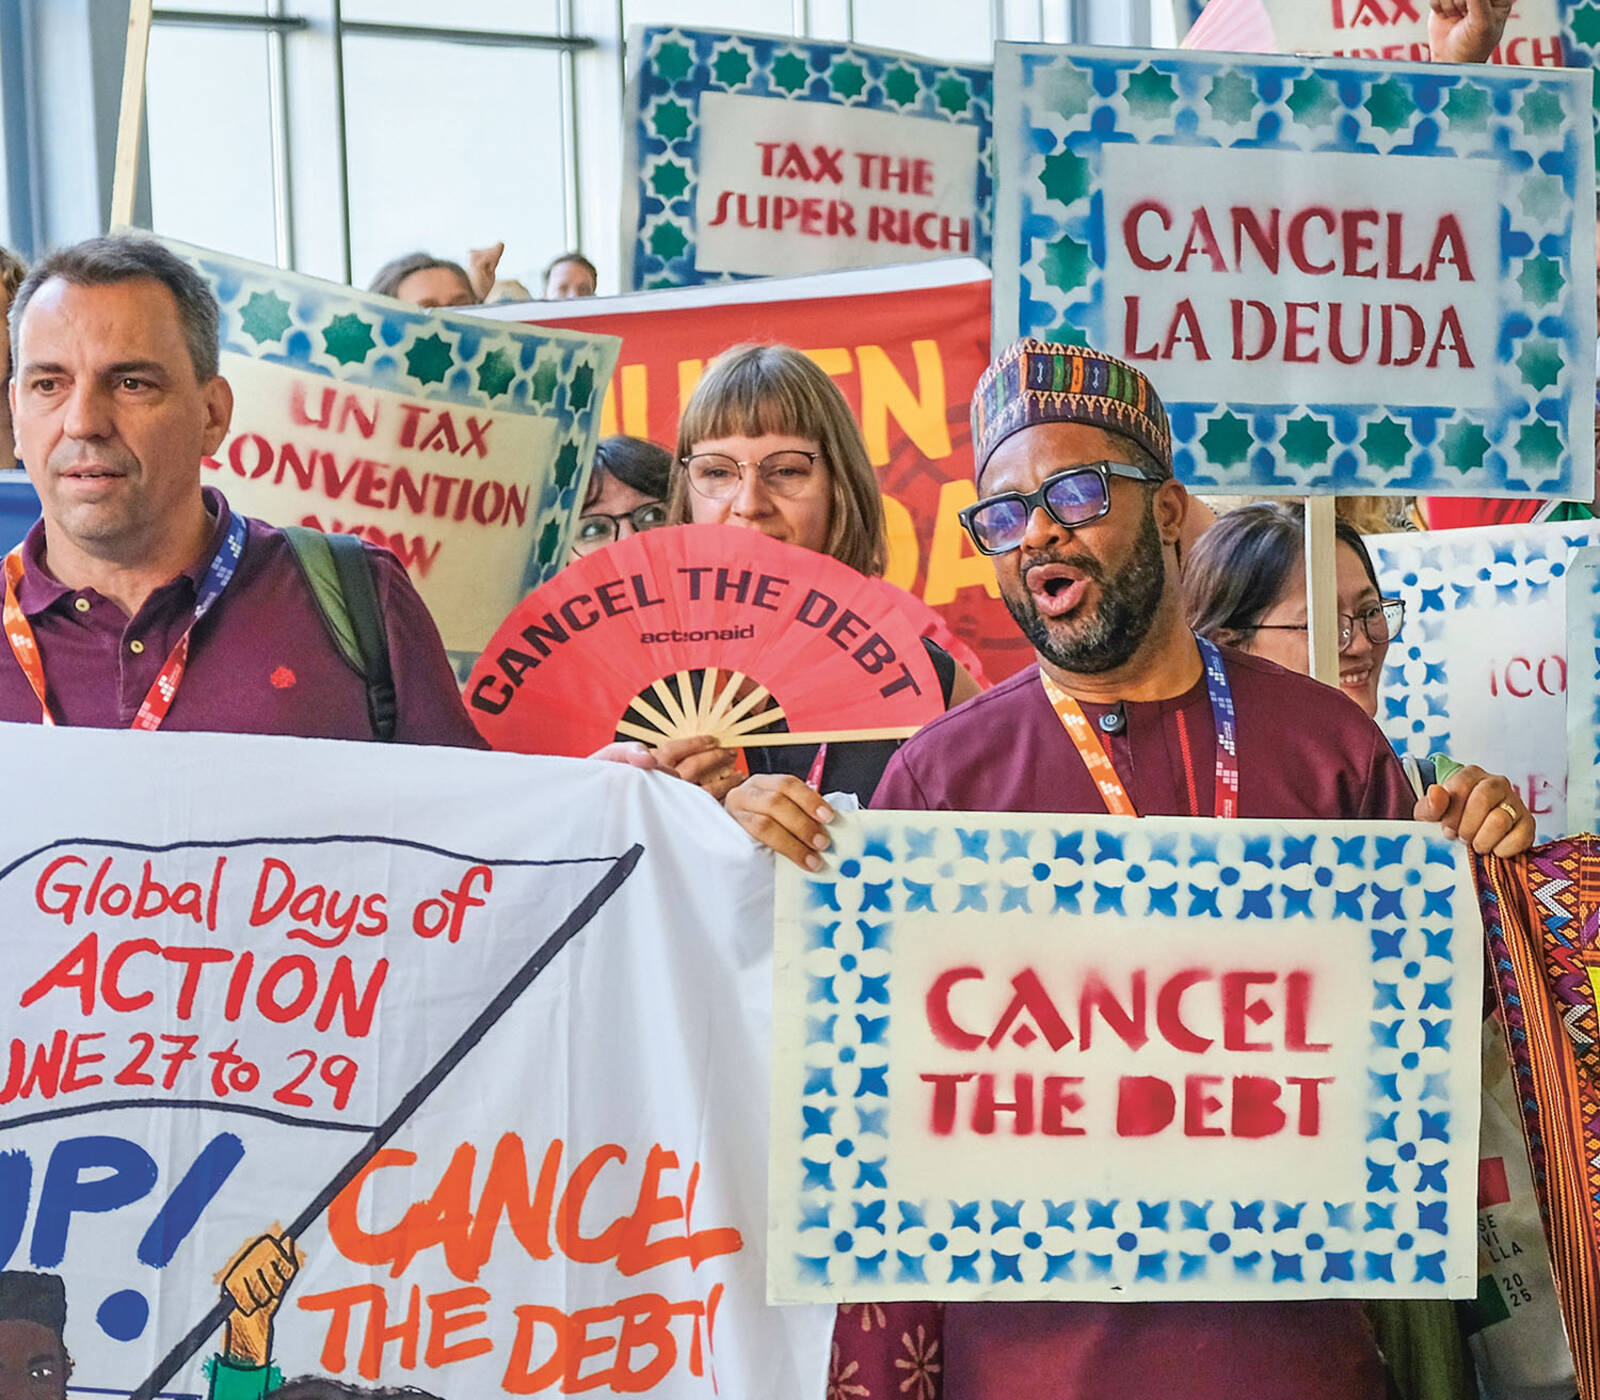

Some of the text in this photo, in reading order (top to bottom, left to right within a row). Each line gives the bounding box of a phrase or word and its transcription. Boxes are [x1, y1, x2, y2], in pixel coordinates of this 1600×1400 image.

[755, 142, 934, 196] TAX THE
[708, 191, 970, 253] SUPER RICH
[1122, 200, 1475, 282] CANCELA
[1124, 296, 1475, 368] LA DEUDA
[290, 380, 493, 459] UN TAX
[202, 432, 531, 528] ONVENTION
[470, 567, 922, 715] CANCEL THE DEBT
[34, 854, 493, 948] Global Days of
[19, 931, 390, 1038] ACTION
[925, 966, 1333, 1054] CANCEL
[114, 1032, 199, 1089] 27
[208, 1039, 260, 1097] to
[273, 1049, 359, 1110] 29
[919, 1072, 1336, 1138] THE DEBT
[327, 1131, 744, 1282] CANCEL
[1488, 1241, 1524, 1263] LLA
[1503, 1273, 1524, 1291] 20
[297, 1283, 495, 1380] THE
[1510, 1288, 1532, 1307] 25
